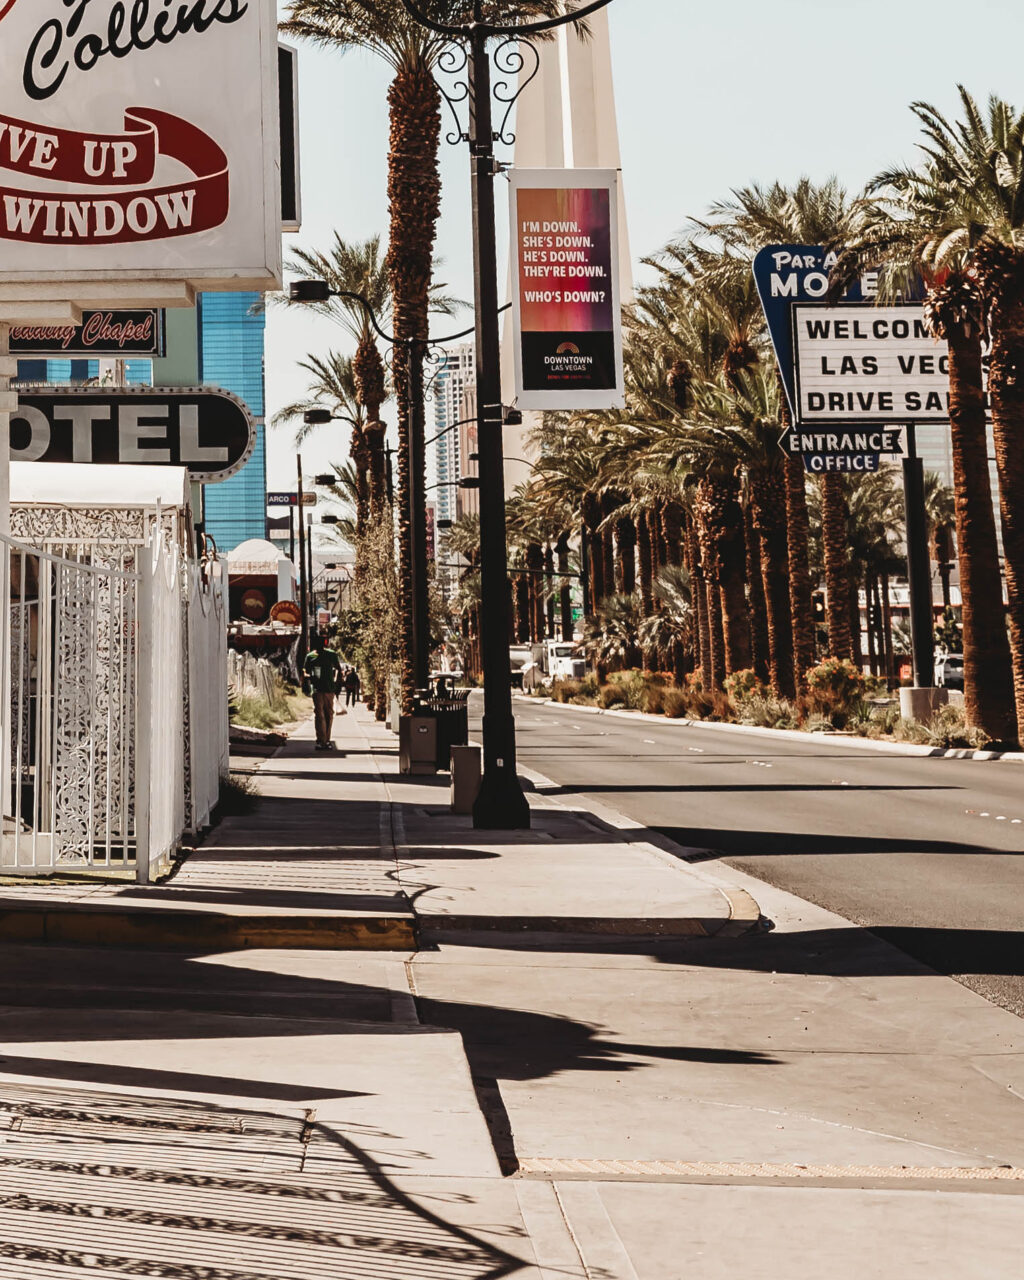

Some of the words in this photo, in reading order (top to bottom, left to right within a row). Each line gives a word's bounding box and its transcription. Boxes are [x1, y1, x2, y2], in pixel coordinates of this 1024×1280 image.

[83, 140, 138, 179] UP
[4, 188, 196, 238] WINDOW
[523, 221, 540, 232] I'M
[542, 221, 581, 232] DOWN.
[523, 236, 553, 247] SHE'S
[555, 236, 594, 247] DOWN.
[523, 251, 548, 262] HE'S
[550, 251, 588, 262] DOWN.
[524, 266, 566, 277] THEY'RE
[568, 266, 607, 277] DOWN.
[525, 291, 561, 302] WHO'S
[564, 291, 605, 302] DOWN?
[82, 312, 153, 348] Chapel
[806, 319, 933, 339] WELCOM
[544, 356, 593, 364] DOWNTOWN
[821, 355, 878, 375] LAS
[808, 391, 894, 411] DRIVE
[9, 404, 228, 463] OTEL
[789, 433, 894, 452] ENTRANCE
[810, 455, 874, 472] OFFICE
